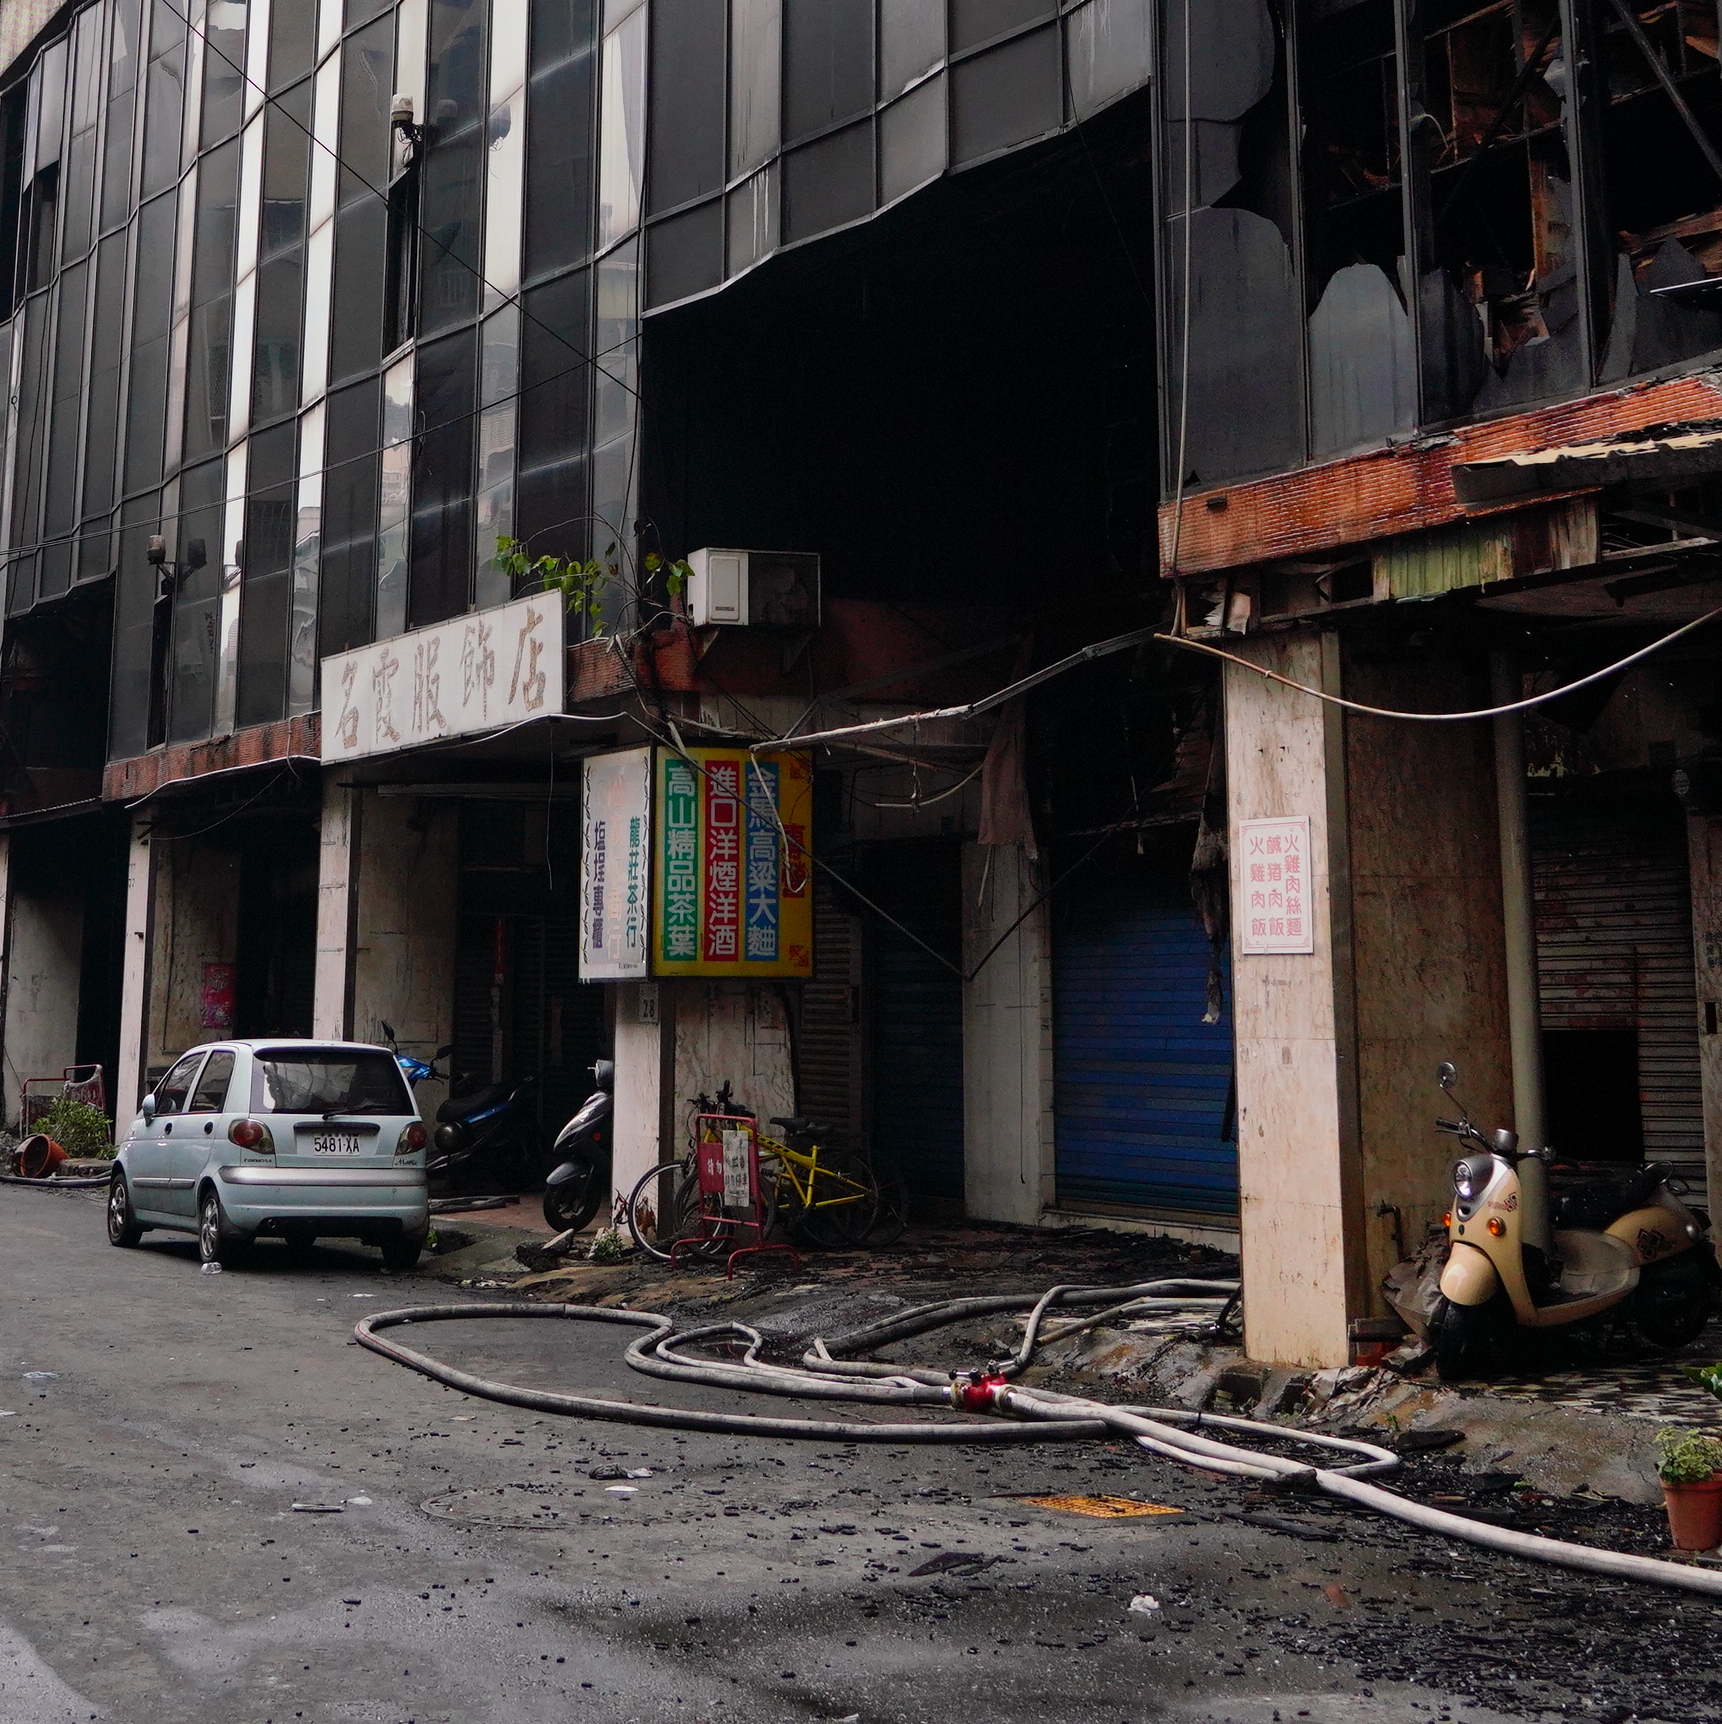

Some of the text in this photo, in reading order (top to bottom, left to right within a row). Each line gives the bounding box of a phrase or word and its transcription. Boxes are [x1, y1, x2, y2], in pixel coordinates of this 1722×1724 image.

[667, 766, 695, 956] 高山精品茶葉
[709, 766, 737, 955] 進口洋煙洋酒
[1250, 836, 1267, 936] 火雞肉飯
[1284, 834, 1302, 936] 火雞肉絲麵
[643, 999, 654, 1017] 28
